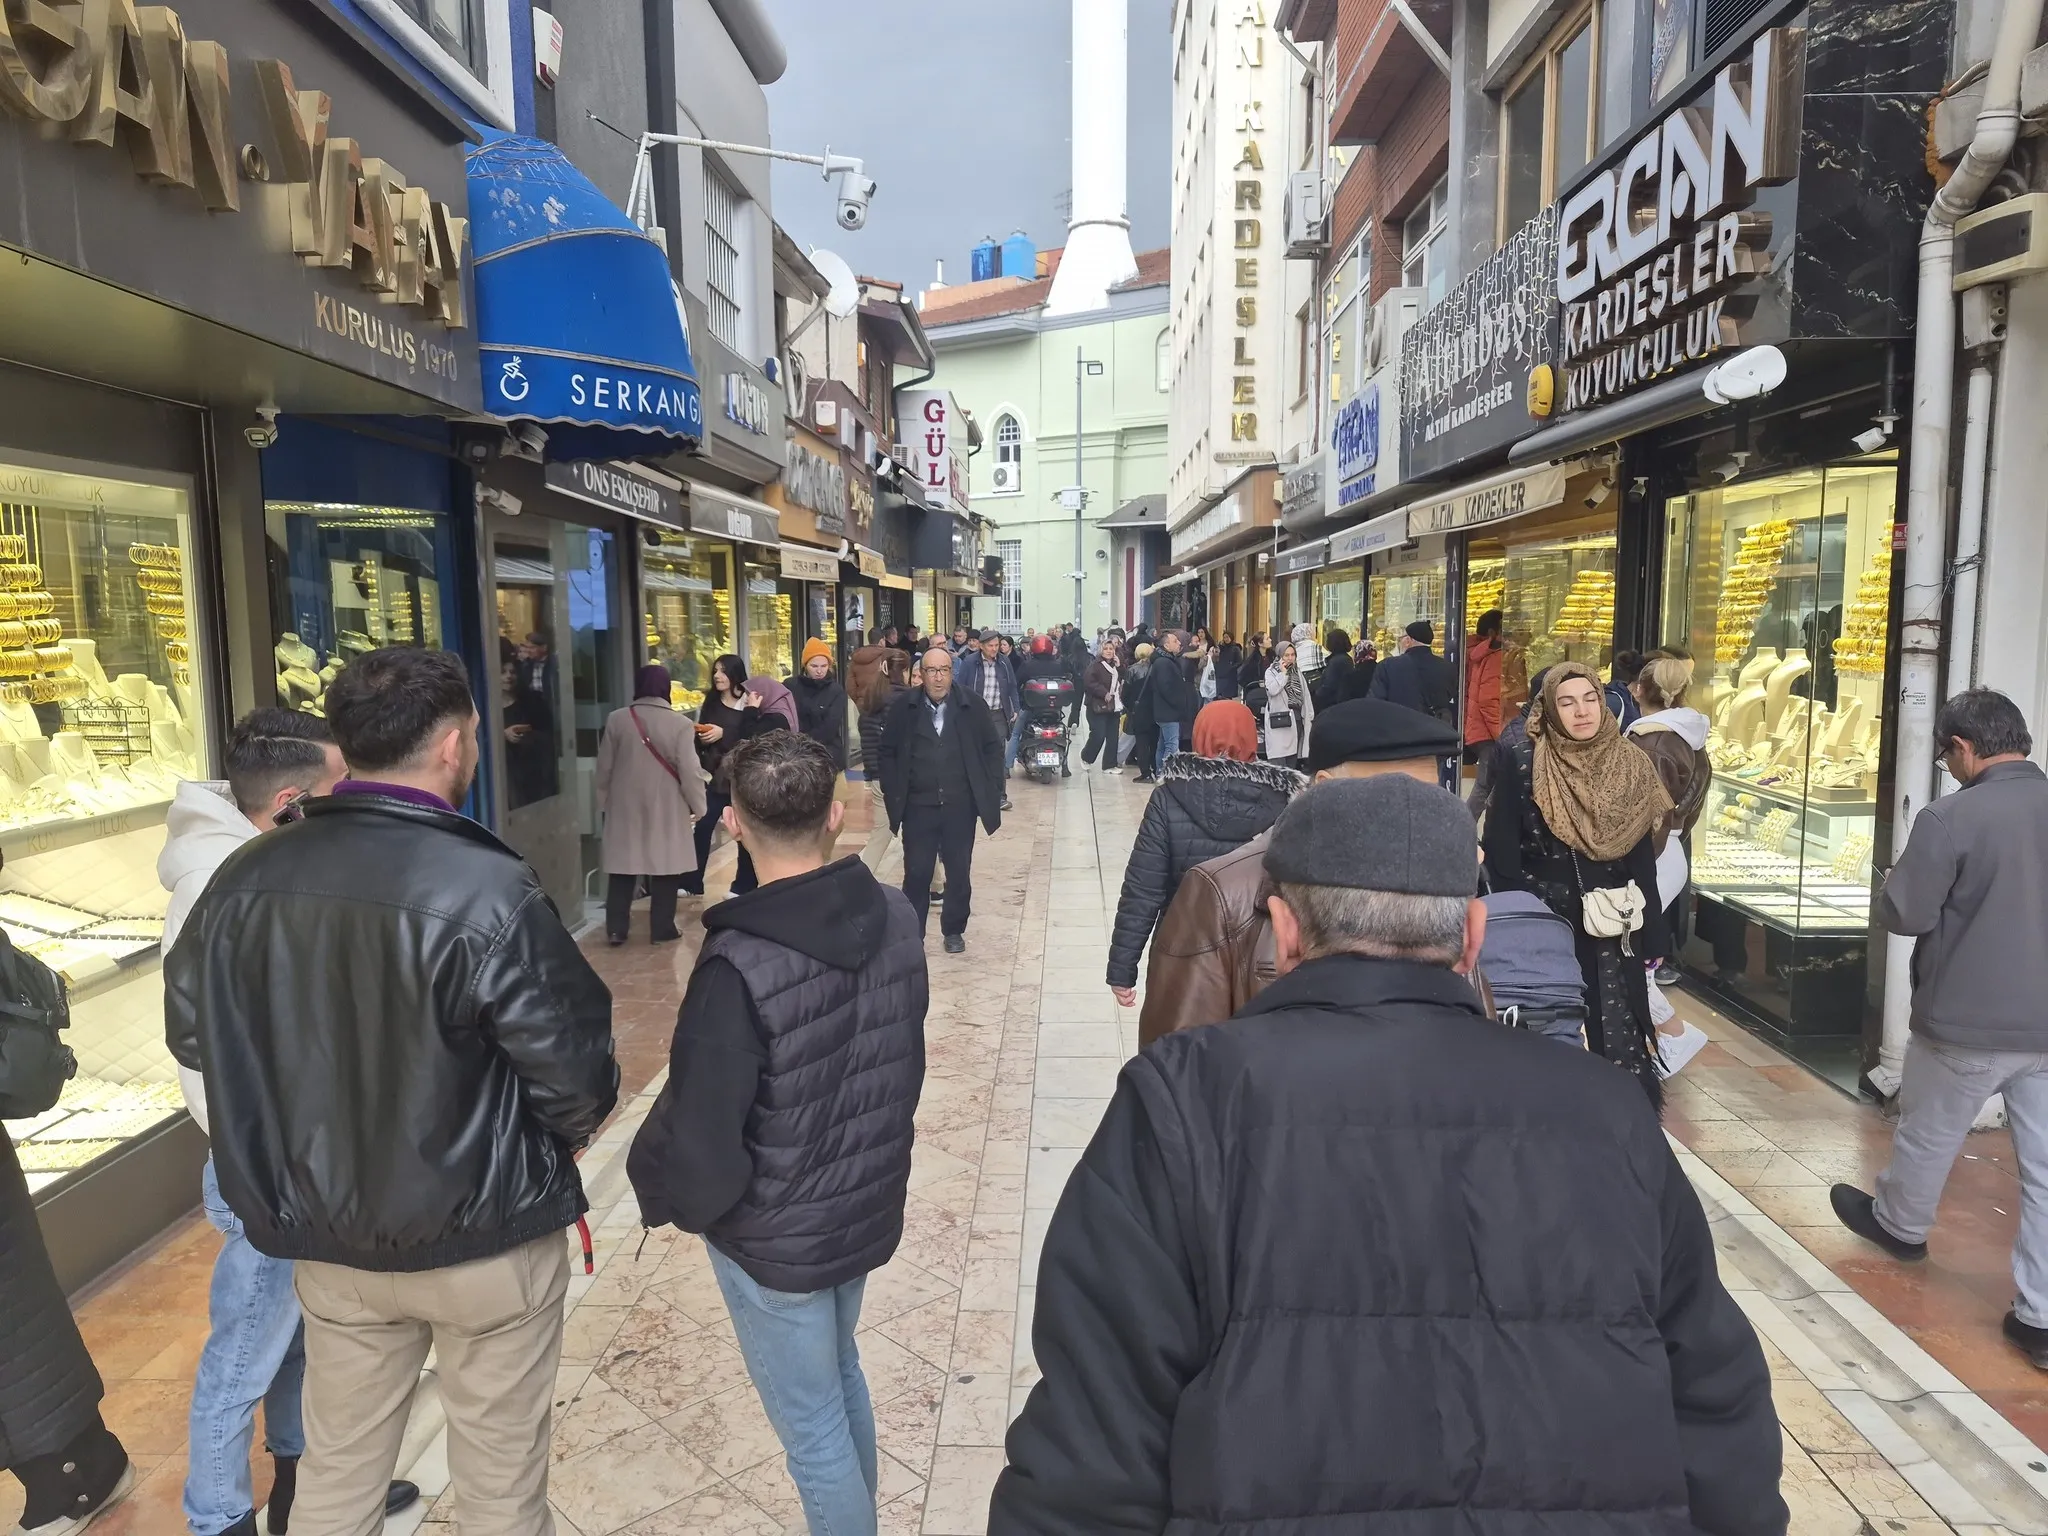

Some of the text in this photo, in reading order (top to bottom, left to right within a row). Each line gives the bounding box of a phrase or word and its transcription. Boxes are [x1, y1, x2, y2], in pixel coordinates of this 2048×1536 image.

[1558, 28, 1775, 304] ERCAN
[1564, 211, 1740, 362] KARDEŞLER
[314, 291, 457, 381] KURULUŞ 1970
[1565, 294, 1728, 411] KUYUMCULUK
[571, 373, 686, 421] SERKAN
[1425, 413, 1450, 442] ALTIN
[1451, 381, 1512, 425] KARDEŞLER
[924, 398, 945, 487] GÜL
[611, 471, 660, 514] ESKİŞEHİR
[727, 508, 753, 538] UĞUR
